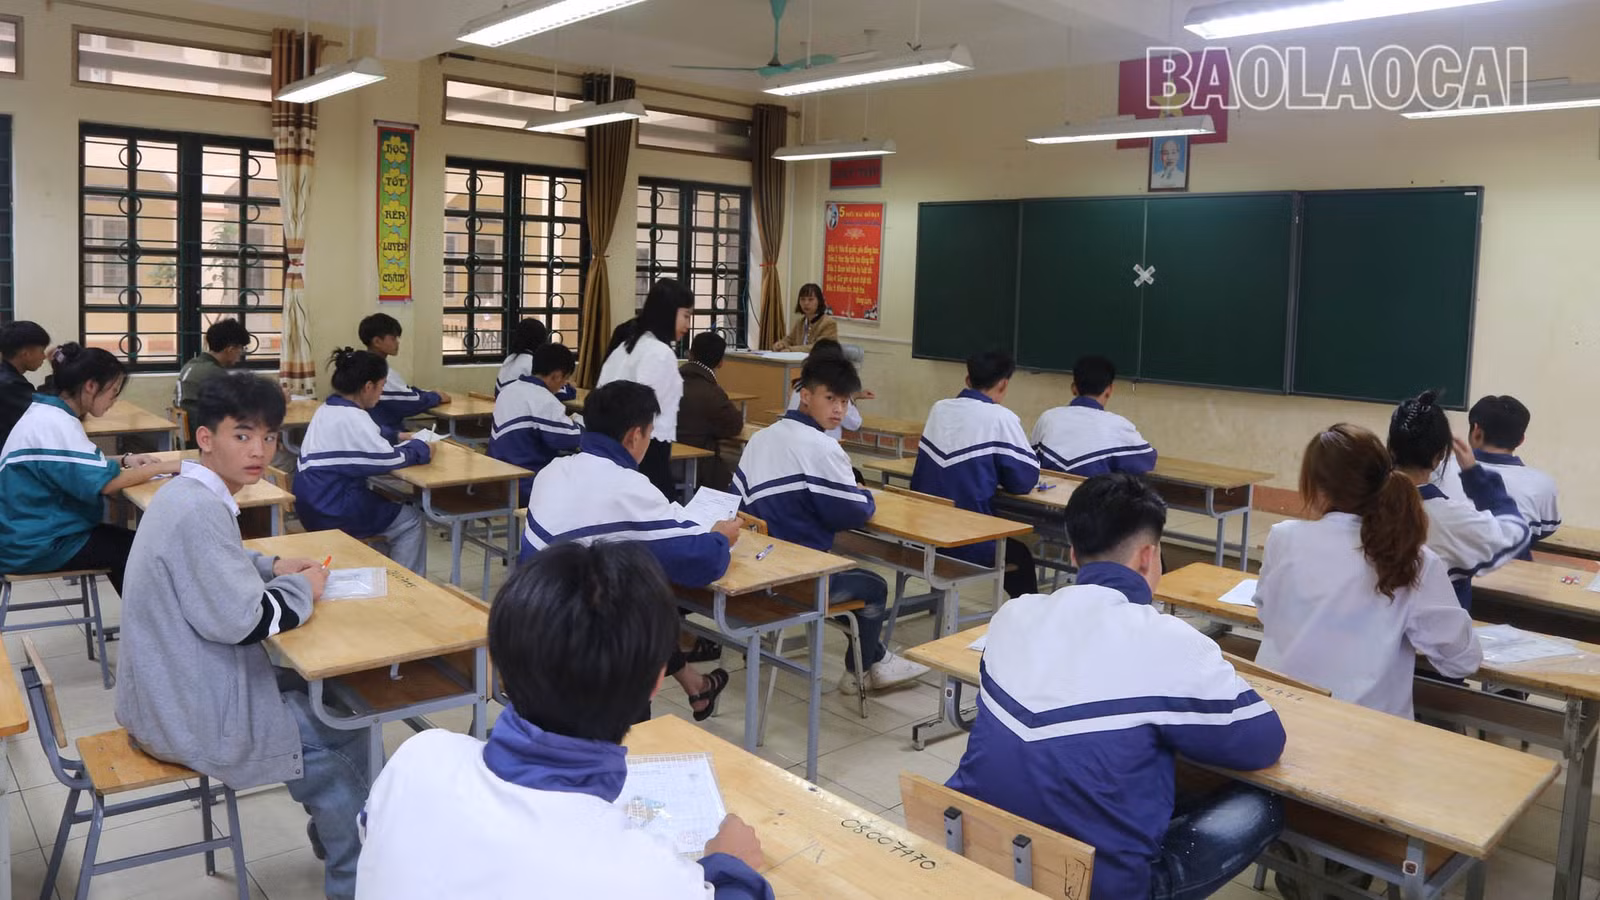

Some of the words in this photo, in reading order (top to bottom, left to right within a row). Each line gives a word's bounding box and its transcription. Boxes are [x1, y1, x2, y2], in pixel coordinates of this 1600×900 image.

[385, 143, 406, 155] HỌC
[385, 175, 406, 187] TỐT
[841, 819, 936, 870] 08007470
